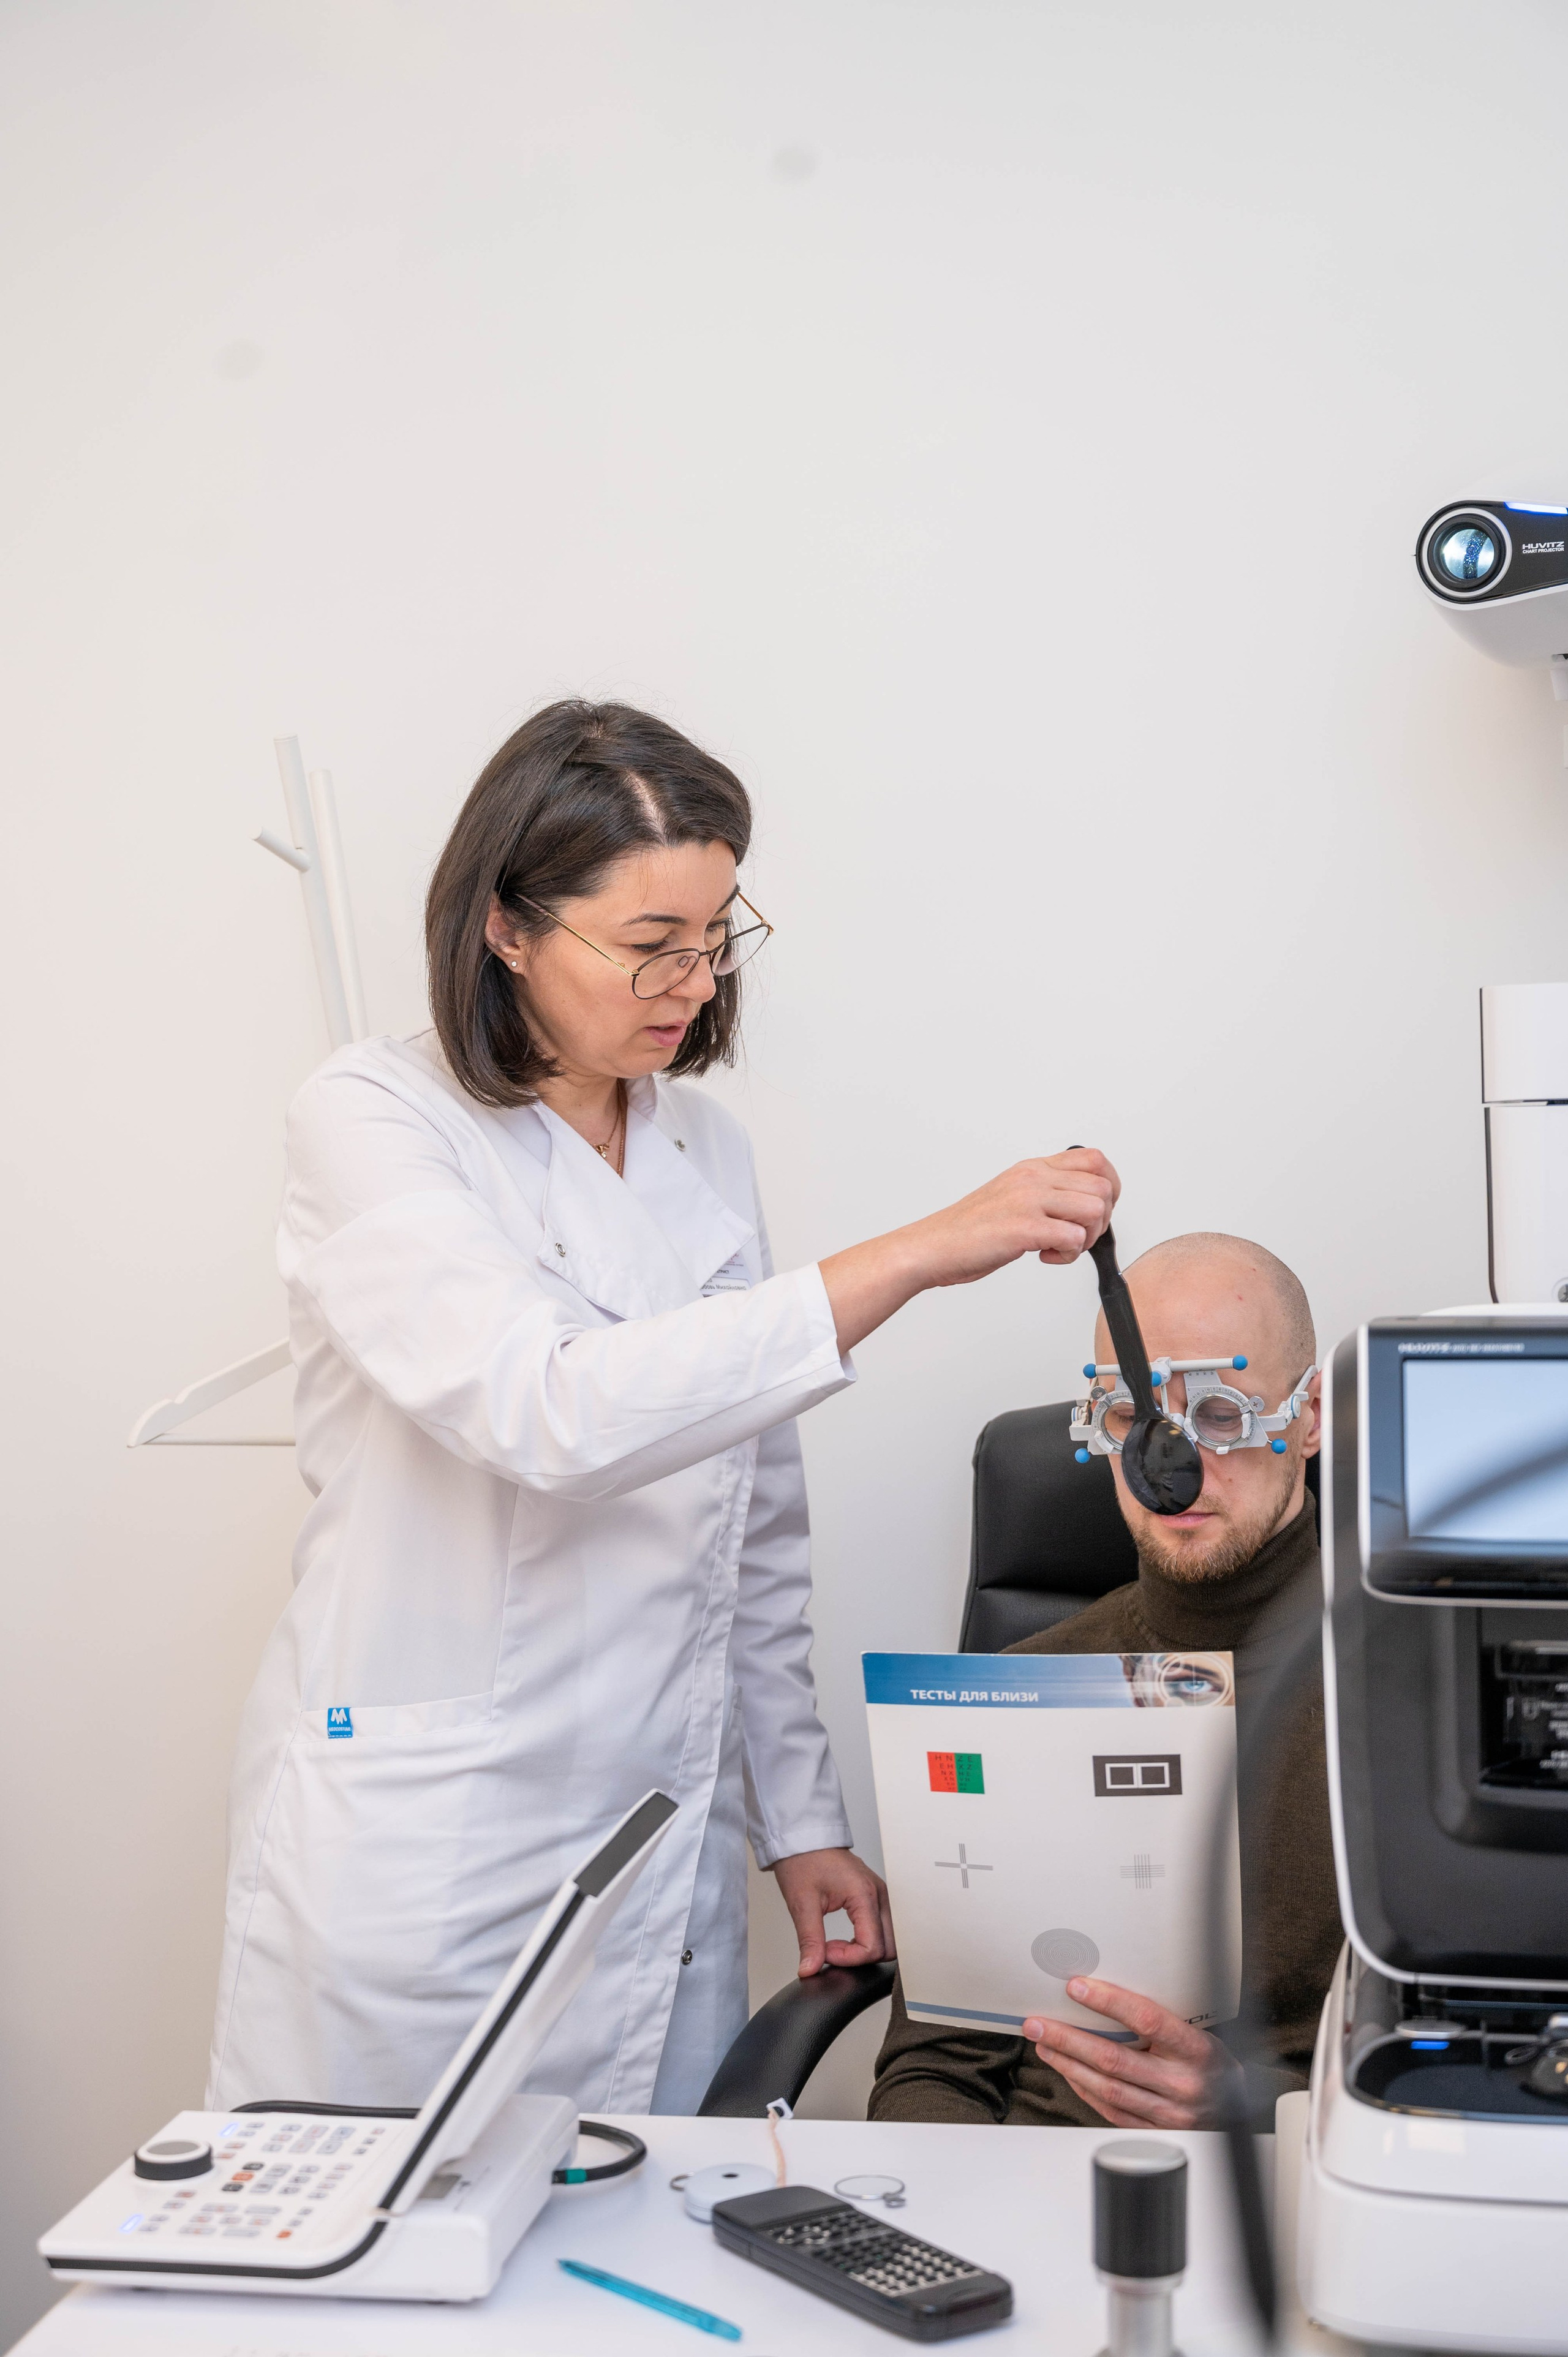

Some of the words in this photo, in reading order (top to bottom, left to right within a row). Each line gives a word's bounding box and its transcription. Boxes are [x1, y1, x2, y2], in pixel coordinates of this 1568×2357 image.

[910, 1689, 956, 1700] ТЕСТЫ
[959, 1691, 989, 1702] ДЛЯ
[991, 1691, 1039, 1702] БЛИЗИ
